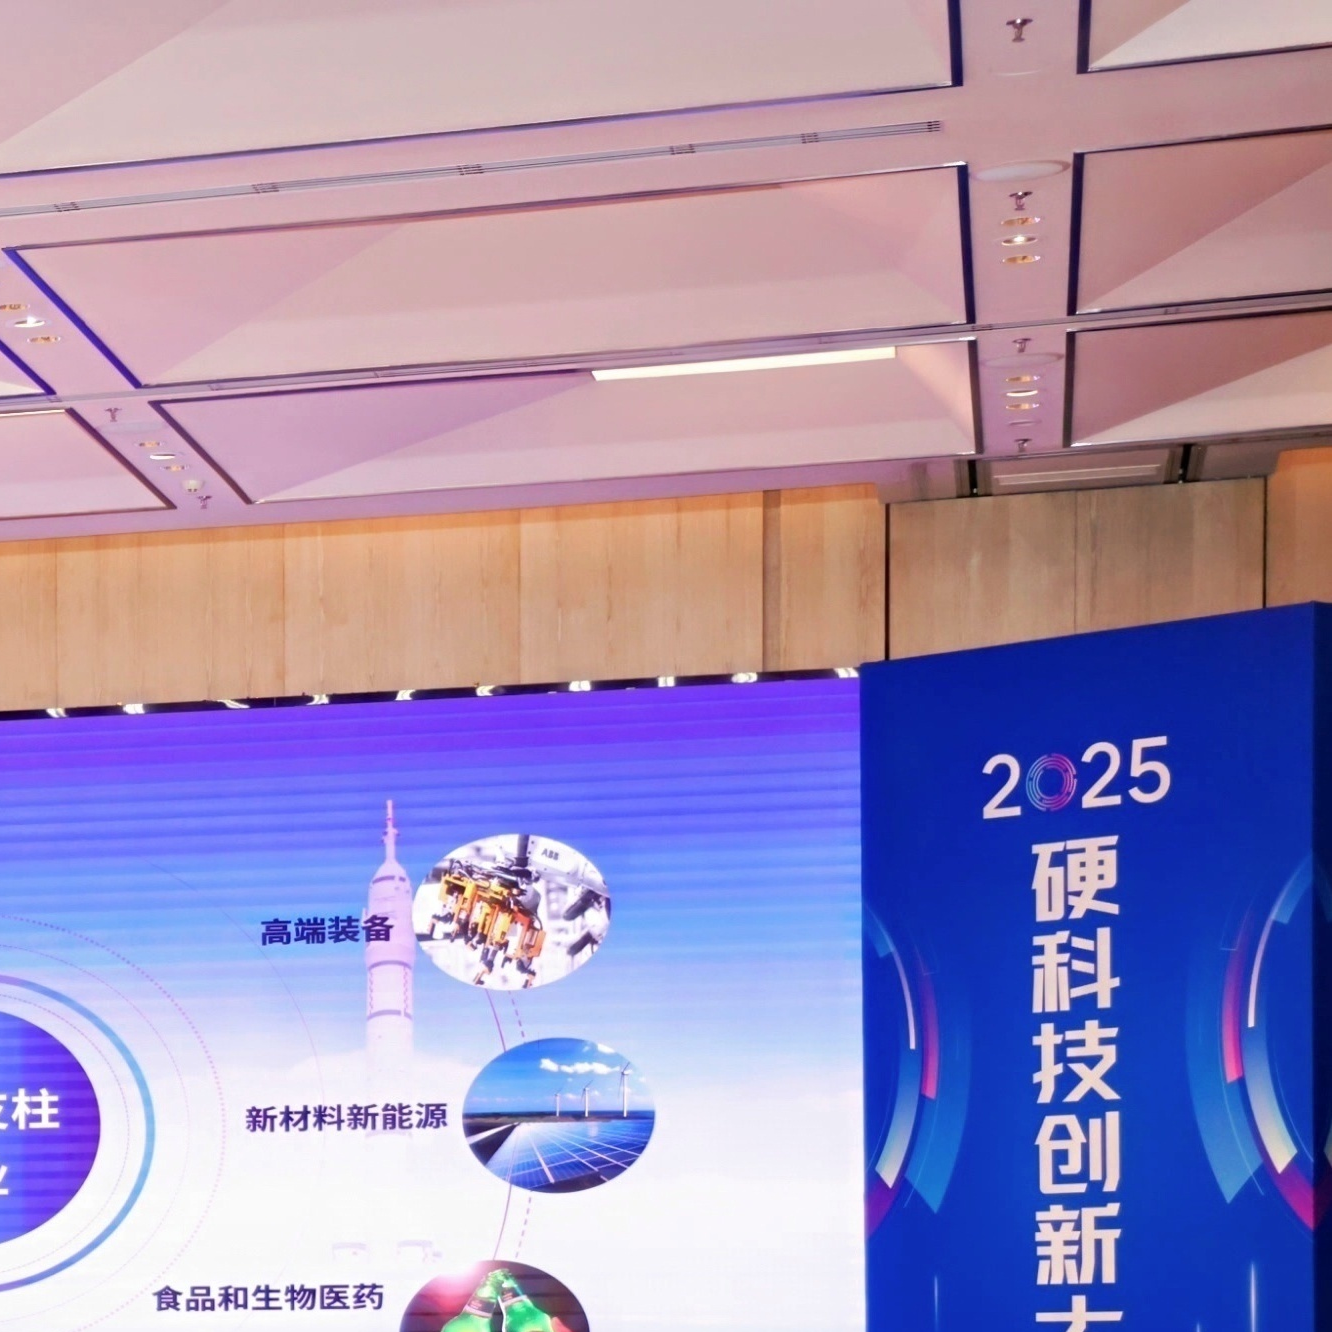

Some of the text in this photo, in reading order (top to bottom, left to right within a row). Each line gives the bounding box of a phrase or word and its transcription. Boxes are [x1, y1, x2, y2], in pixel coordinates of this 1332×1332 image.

[981, 736, 1171, 820] 2025
[259, 914, 394, 947] 高端装备
[245, 1102, 449, 1133] 新材料新能源
[152, 1283, 384, 1312] 食品和生物医药
